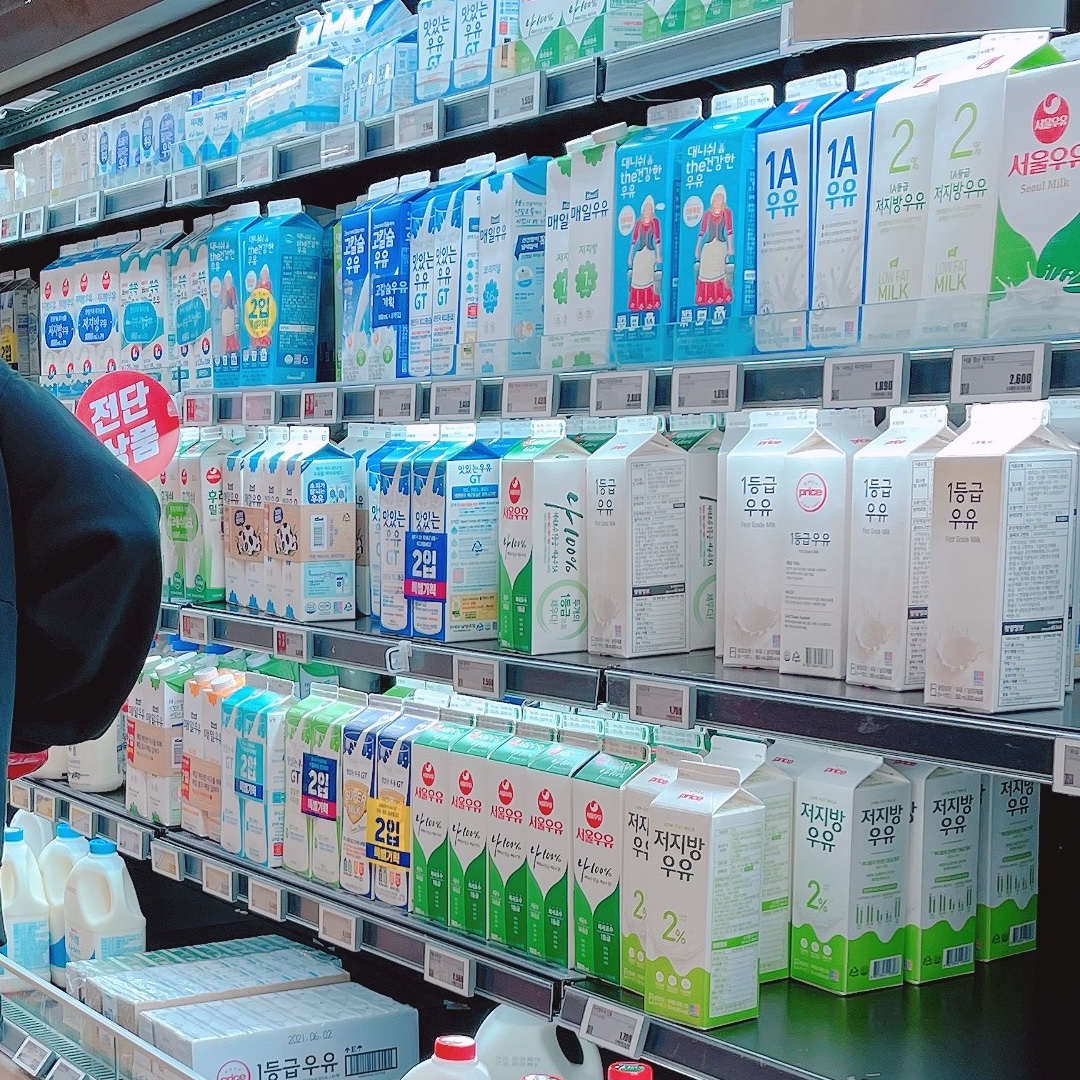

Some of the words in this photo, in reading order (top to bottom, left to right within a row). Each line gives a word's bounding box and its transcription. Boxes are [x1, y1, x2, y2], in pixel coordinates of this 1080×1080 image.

[422, 15, 451, 35] 맛있는
[463, 22, 483, 41] 우유
[426, 36, 446, 54] 우유
[827, 134, 858, 179] 1A
[765, 147, 798, 190] 1A
[620, 185, 636, 200] 우유
[685, 175, 704, 190] 우유
[933, 178, 988, 203] 저지방우유
[1020, 179, 1046, 195] Seoul
[1047, 176, 1070, 191] Milk
[765, 188, 800, 220] 우유
[825, 177, 858, 210] 우유
[875, 191, 926, 216] 저지방우유
[570, 200, 610, 222] 매일우유
[480, 224, 508, 245] 매일우유
[373, 250, 390, 271] 우유
[412, 250, 434, 272] 맛있는
[435, 244, 458, 266] 맛있는
[345, 256, 361, 276] 우유
[437, 266, 452, 287] 우유
[413, 272, 430, 292] 우유
[877, 284, 910, 301] MILK
[933, 273, 967, 293] MILK
[414, 292, 428, 311] GT
[437, 287, 449, 306] GT
[248, 297, 270, 319] 2입
[89, 380, 150, 437] 전단
[469, 474, 482, 484] GT
[595, 478, 617, 496] 1등급
[741, 475, 777, 496] 1등급
[863, 478, 893, 499] 1등급
[798, 487, 823, 498] price
[947, 481, 984, 503] 1등급
[502, 506, 529, 521] 서울우유
[596, 500, 614, 518] 우유
[743, 498, 773, 517] 우유
[865, 502, 889, 523] 우유
[382, 510, 407, 529] 맛있는
[415, 511, 441, 530] 맛있는
[948, 508, 979, 530] 우유
[385, 530, 401, 548] 우유
[790, 531, 831, 547] 1등급우유
[412, 549, 437, 579] 2입
[823, 766, 848, 776] price
[307, 769, 329, 799] 2입
[1000, 779, 1034, 798] 저지방
[345, 788, 367, 806] SUPER
[414, 786, 444, 805] 서울우유
[451, 795, 482, 814] 서울우유
[677, 791, 704, 803] price
[932, 794, 975, 816] 저지방
[490, 805, 523, 824] 서울우유
[861, 804, 904, 827] 저지방
[1006, 796, 1030, 817] 우유
[529, 815, 564, 836] 서울우유
[800, 802, 846, 833] 저지방
[939, 814, 968, 836] 우유
[374, 817, 400, 848] 2입
[576, 827, 614, 849] 서울우유
[806, 826, 836, 852] 우유
[867, 825, 896, 846] 우유
[654, 829, 706, 861] 저지방
[660, 855, 695, 882] 우유
[806, 879, 829, 913] 2%
[661, 910, 688, 945] 2%
[287, 1029, 333, 1045] 2021.06.02
